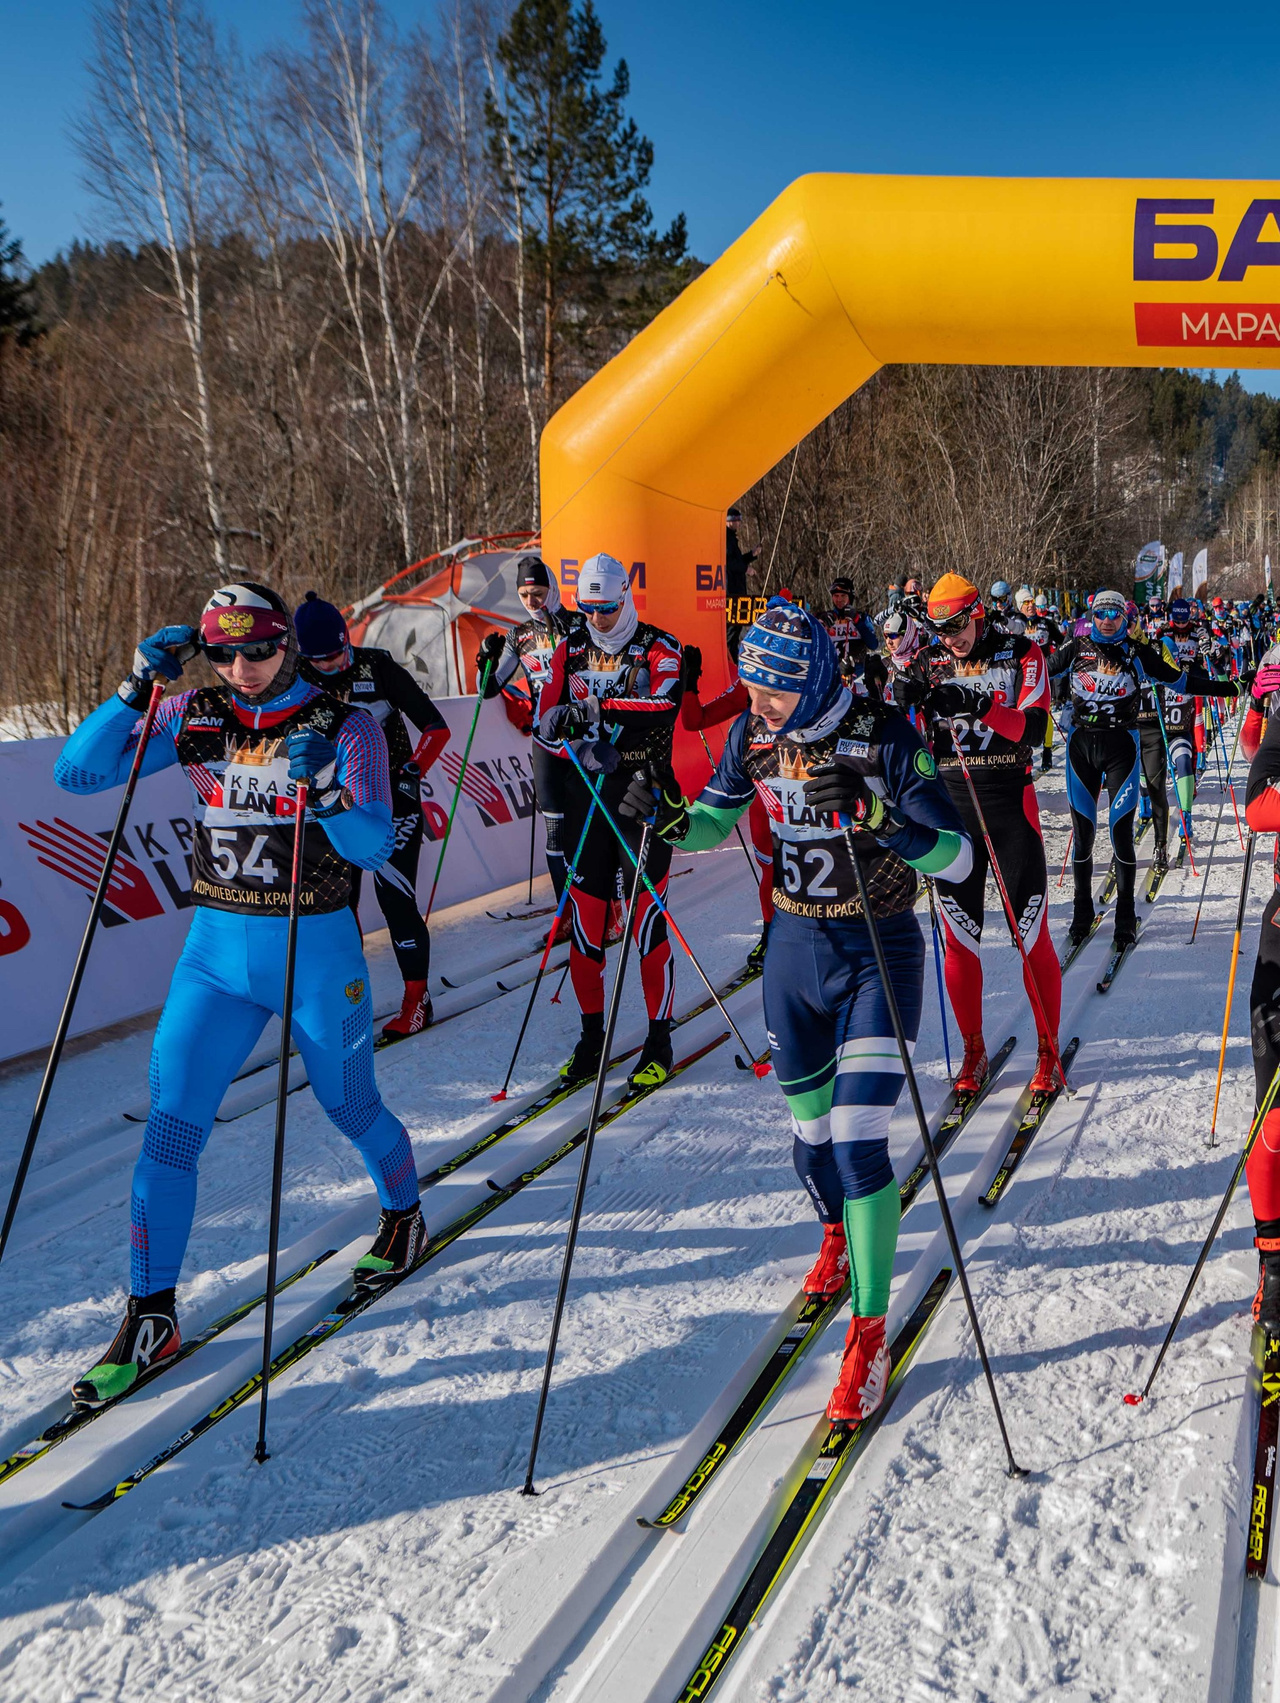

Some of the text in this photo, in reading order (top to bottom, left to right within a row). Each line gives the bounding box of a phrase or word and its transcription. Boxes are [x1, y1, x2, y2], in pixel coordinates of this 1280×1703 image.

[561, 559, 646, 585] БМ
[696, 564, 726, 591] БА
[960, 681, 1006, 690] KRAS
[1097, 685, 1127, 696] LAND
[188, 717, 224, 727] БАМ
[951, 718, 995, 752] 29
[491, 752, 533, 782] KR
[621, 752, 646, 761] РАСКИ
[988, 753, 1016, 765] КРАСКИ
[230, 775, 298, 796] KRAS
[229, 789, 298, 816] LAND
[134, 818, 193, 858] KR
[394, 812, 420, 850] LYNX
[210, 829, 279, 884] 54
[781, 841, 838, 897] 52
[193, 879, 261, 905] КОРОЛЕВСКИЕ
[826, 901, 864, 918] КРАСК
[1020, 894, 1043, 940] ECSO
[986, 1169, 1008, 1201] FISCHER
[133, 1429, 194, 1480] FISCHER
[657, 1442, 727, 1525] FISCHER
[1248, 1484, 1267, 1561] FISCHER
[677, 1624, 738, 1703] FISCH
